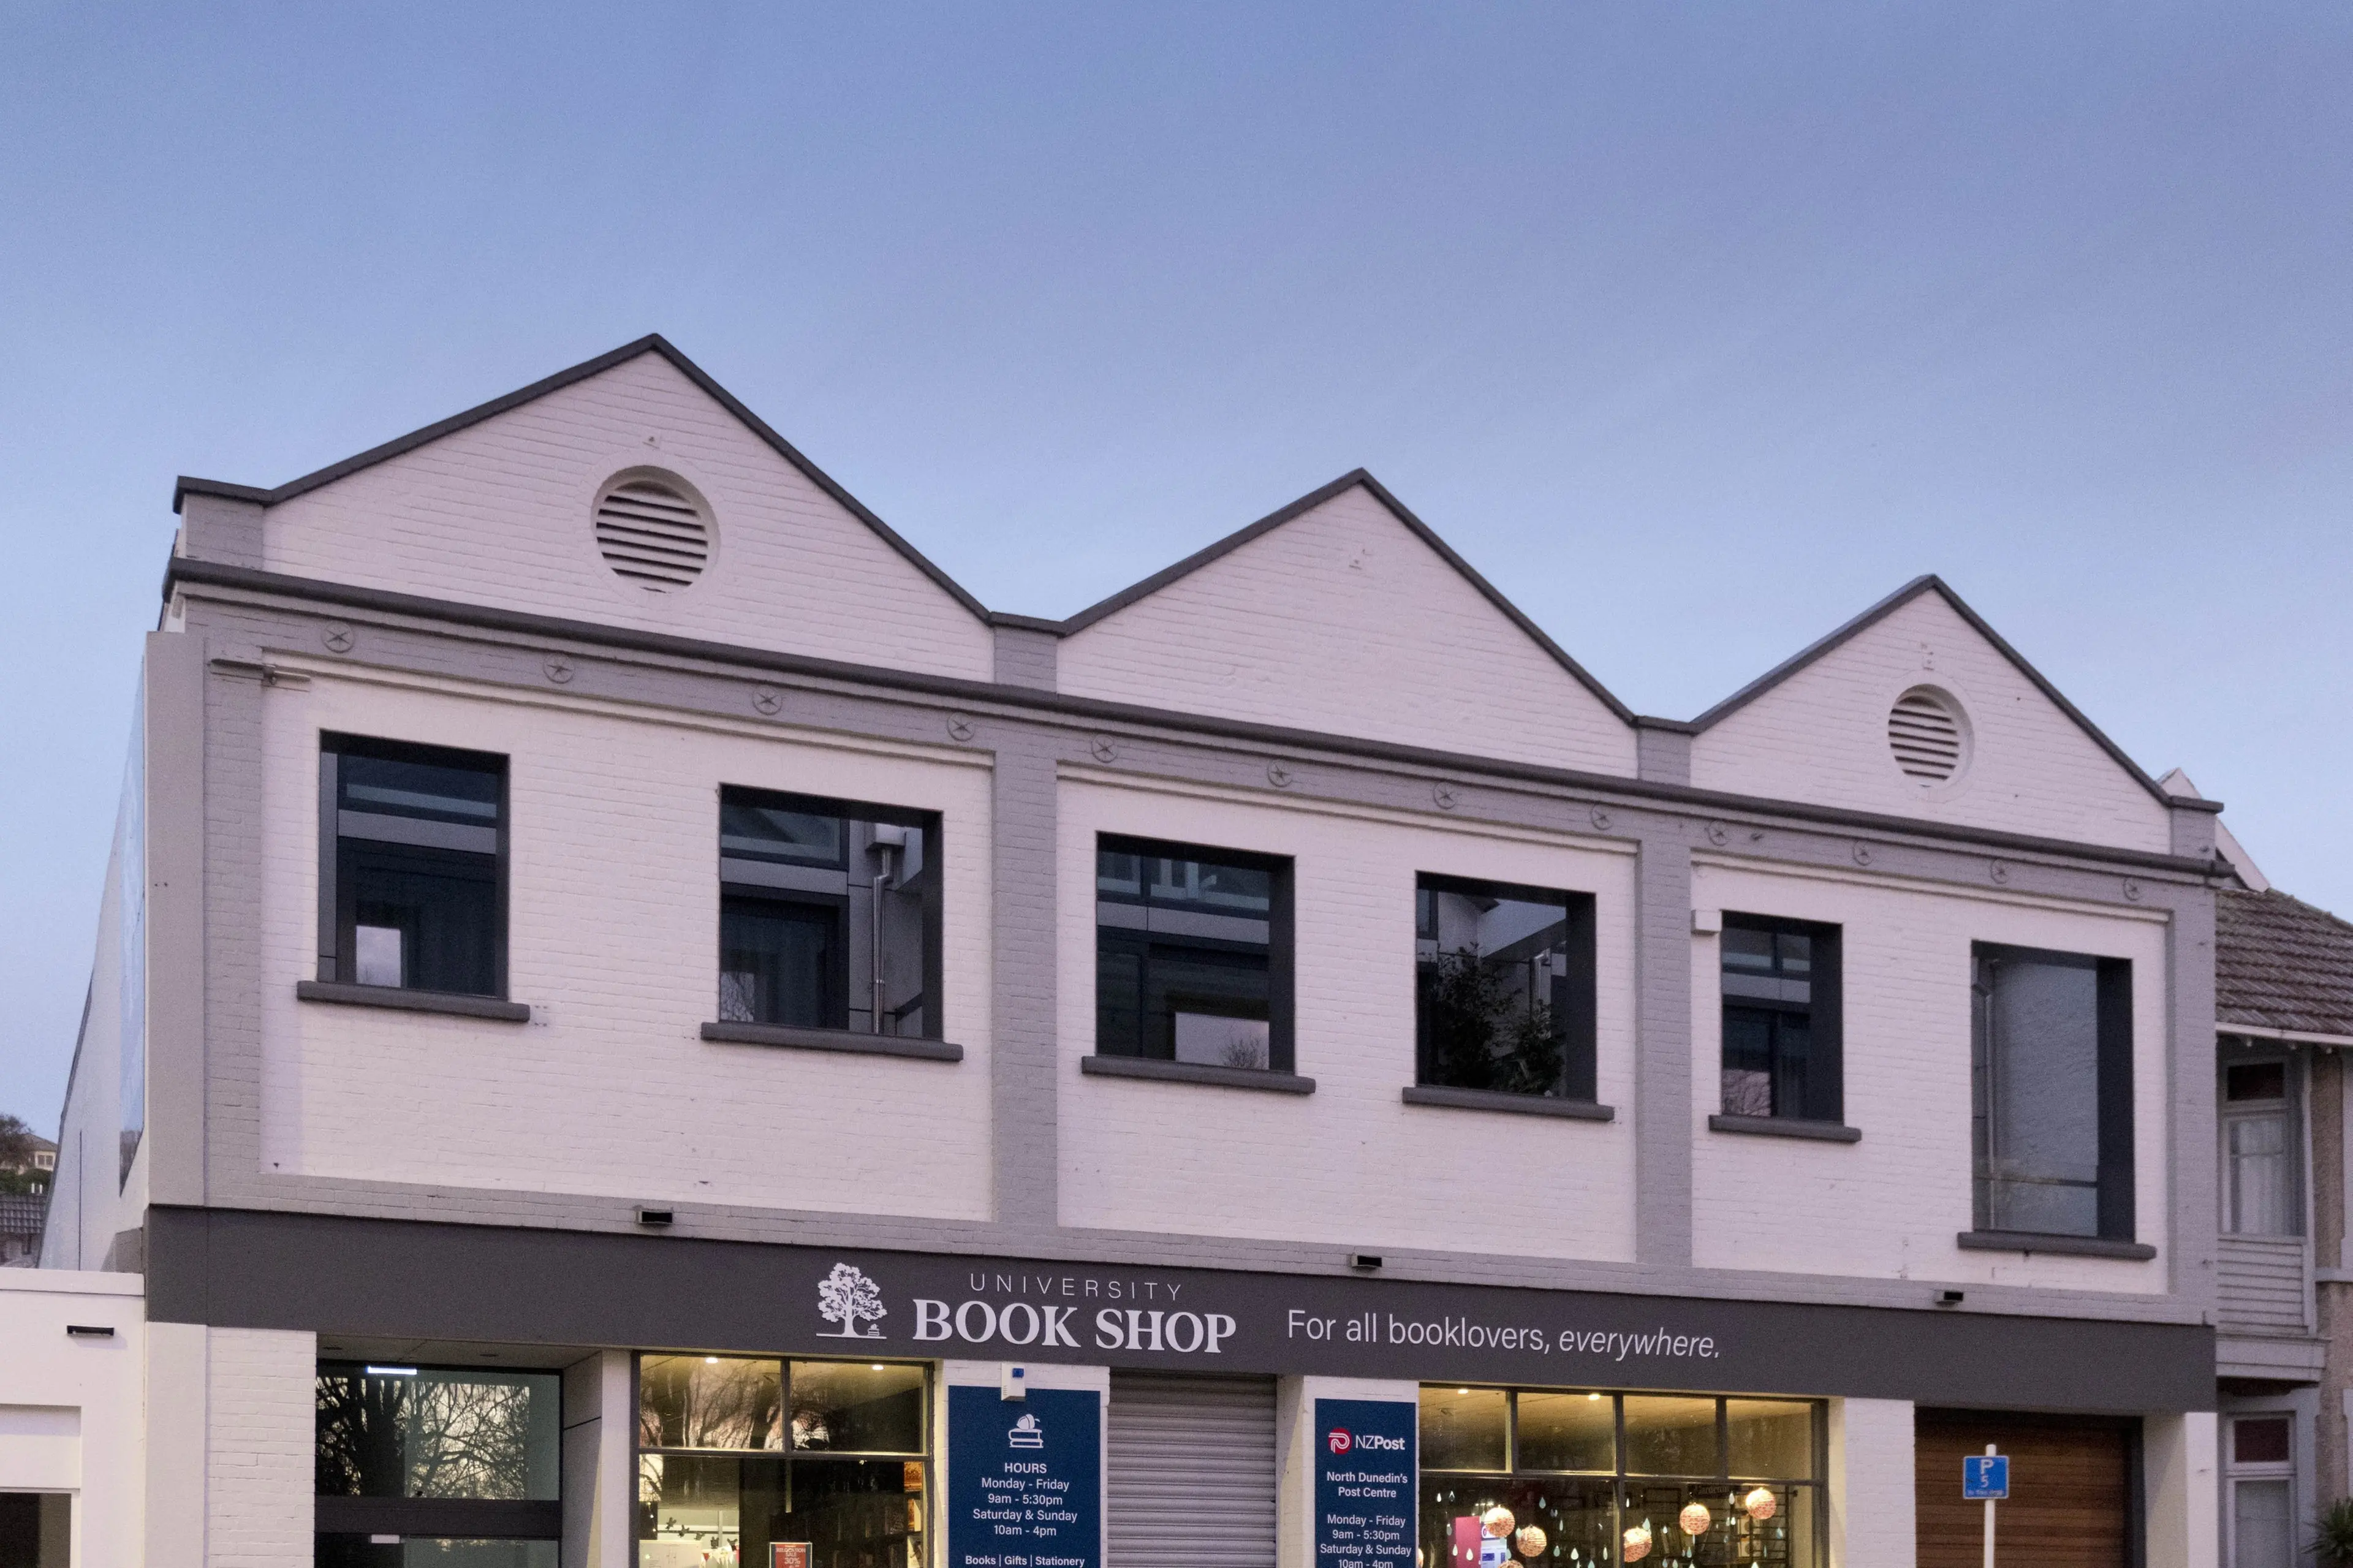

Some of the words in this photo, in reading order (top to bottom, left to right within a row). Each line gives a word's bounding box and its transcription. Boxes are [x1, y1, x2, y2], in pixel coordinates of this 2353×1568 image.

[970, 1273, 1181, 1301] UNIVERSITY
[912, 1299, 1082, 1348] BOOK
[1096, 1308, 1237, 1354] SHOP
[1289, 1309, 1336, 1341] For
[1346, 1312, 1377, 1343] all
[1389, 1313, 1550, 1355] booklovers,
[1559, 1327, 1719, 1362] everywhere.
[1355, 1434, 1406, 1450] NZPost
[1004, 1462, 1047, 1474] HOURS
[1980, 1458, 1995, 1475] P
[1327, 1471, 1355, 1482] North
[1358, 1472, 1408, 1484] Dunedin's
[1980, 1475, 1989, 1488] 5
[981, 1477, 1026, 1491] Monday
[1036, 1479, 1070, 1493] Friday
[1338, 1487, 1360, 1497] Post
[1363, 1487, 1397, 1498] Centre
[988, 1493, 1012, 1504] 9am
[1022, 1494, 1063, 1507] 5:30pm
[972, 1508, 1022, 1523] Saturday
[1025, 1510, 1034, 1520] &
[1037, 1510, 1078, 1524] Sunday
[1327, 1514, 1366, 1528] Monday
[1376, 1515, 1406, 1528] Friday
[994, 1524, 1022, 1535] 10am
[1033, 1526, 1057, 1538] 4pm
[1332, 1529, 1354, 1539] 9am
[1363, 1530, 1400, 1542] 5:30pm
[1320, 1543, 1363, 1557] Saturday
[1365, 1544, 1374, 1555] &
[1376, 1544, 1412, 1558] Sunday
[964, 1555, 996, 1565] Books
[1004, 1556, 1028, 1566] Gifts
[1035, 1556, 1085, 1568] Stationery
[1338, 1559, 1363, 1568] 10am
[1372, 1559, 1393, 1568] 4pm
